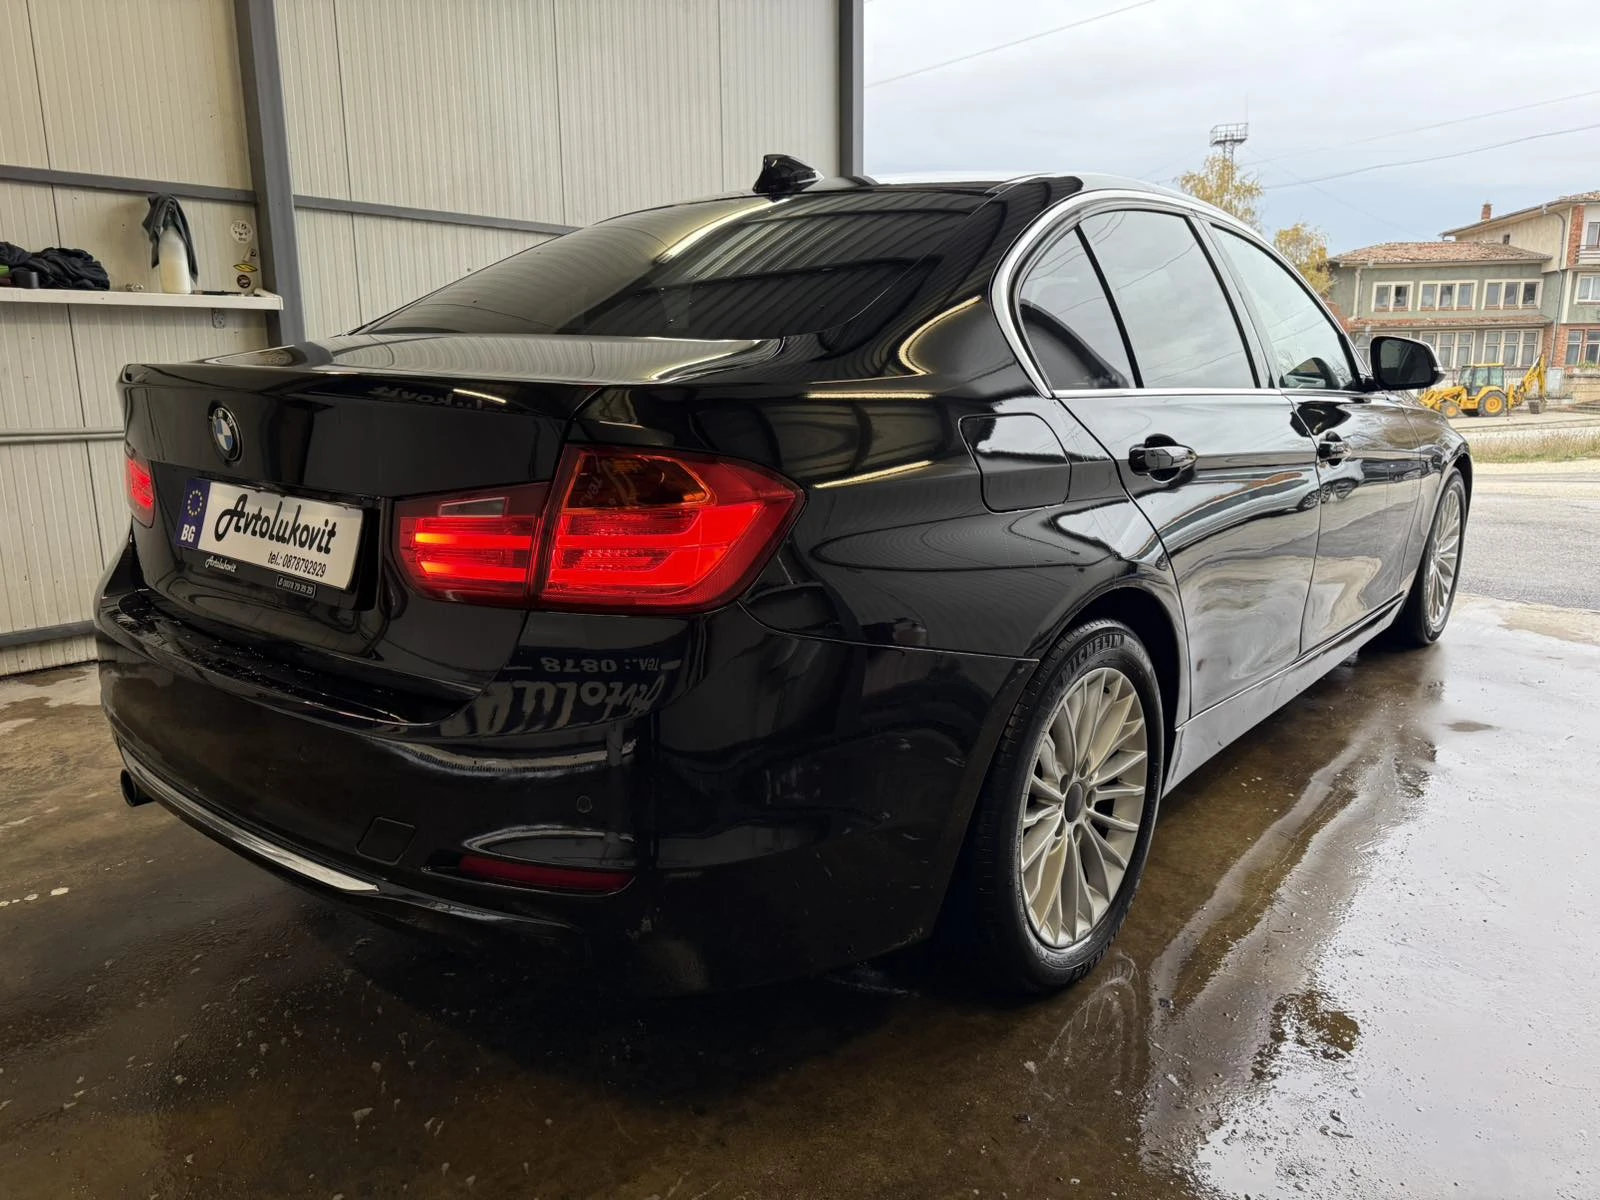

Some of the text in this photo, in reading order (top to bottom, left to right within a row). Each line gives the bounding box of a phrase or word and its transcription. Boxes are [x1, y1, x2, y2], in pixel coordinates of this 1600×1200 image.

[181, 524, 195, 543] BG
[214, 493, 337, 555] Avtolukovit
[282, 553, 327, 578] 0878792929
[1060, 633, 1122, 684] MICHELIN
